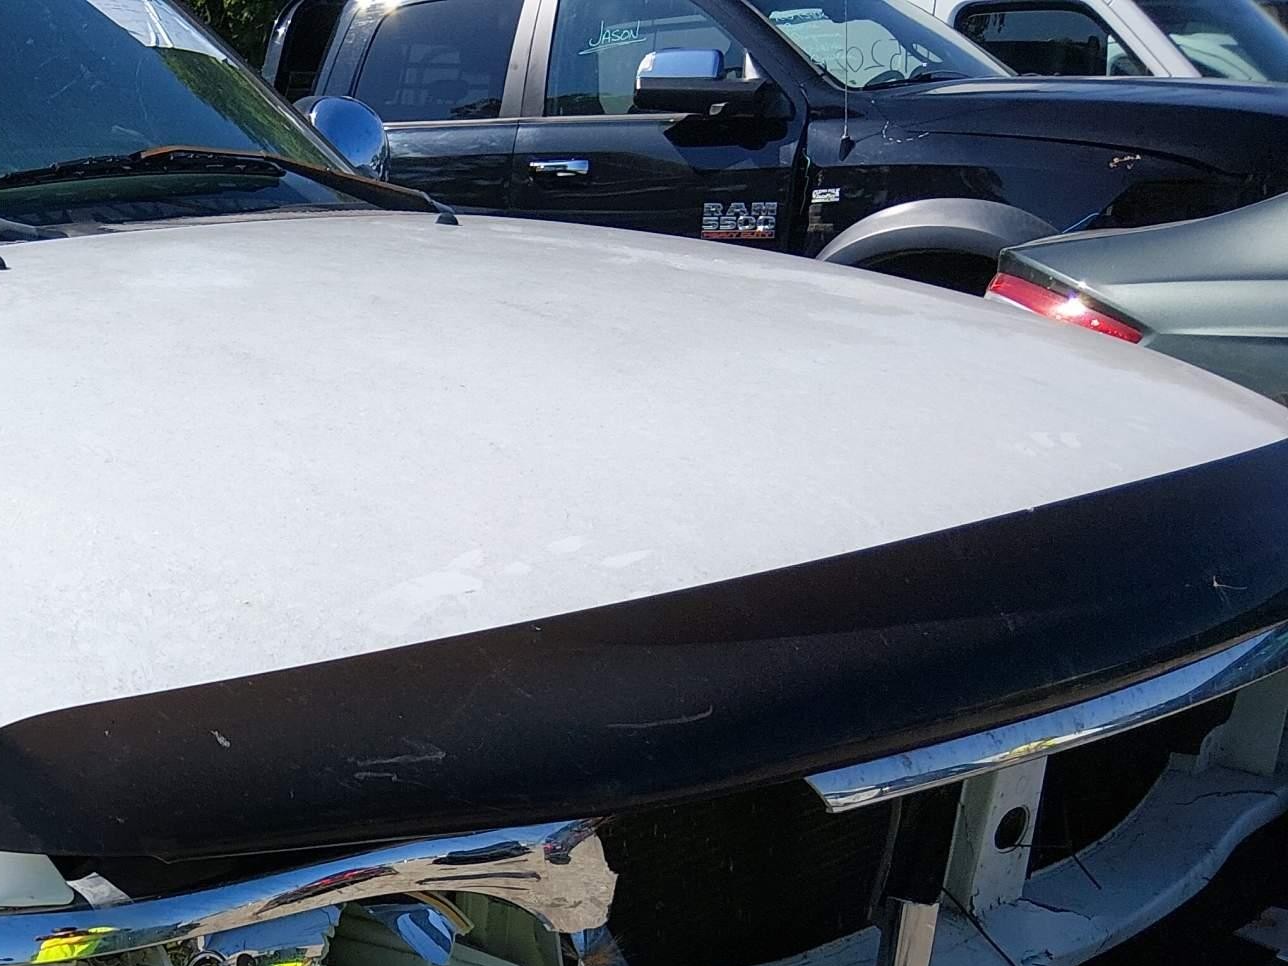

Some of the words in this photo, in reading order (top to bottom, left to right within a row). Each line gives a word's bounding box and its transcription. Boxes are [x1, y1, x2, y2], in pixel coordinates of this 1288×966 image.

[588, 20, 641, 47] JASON
[703, 202, 777, 216] RAM
[701, 215, 776, 231] 5500
